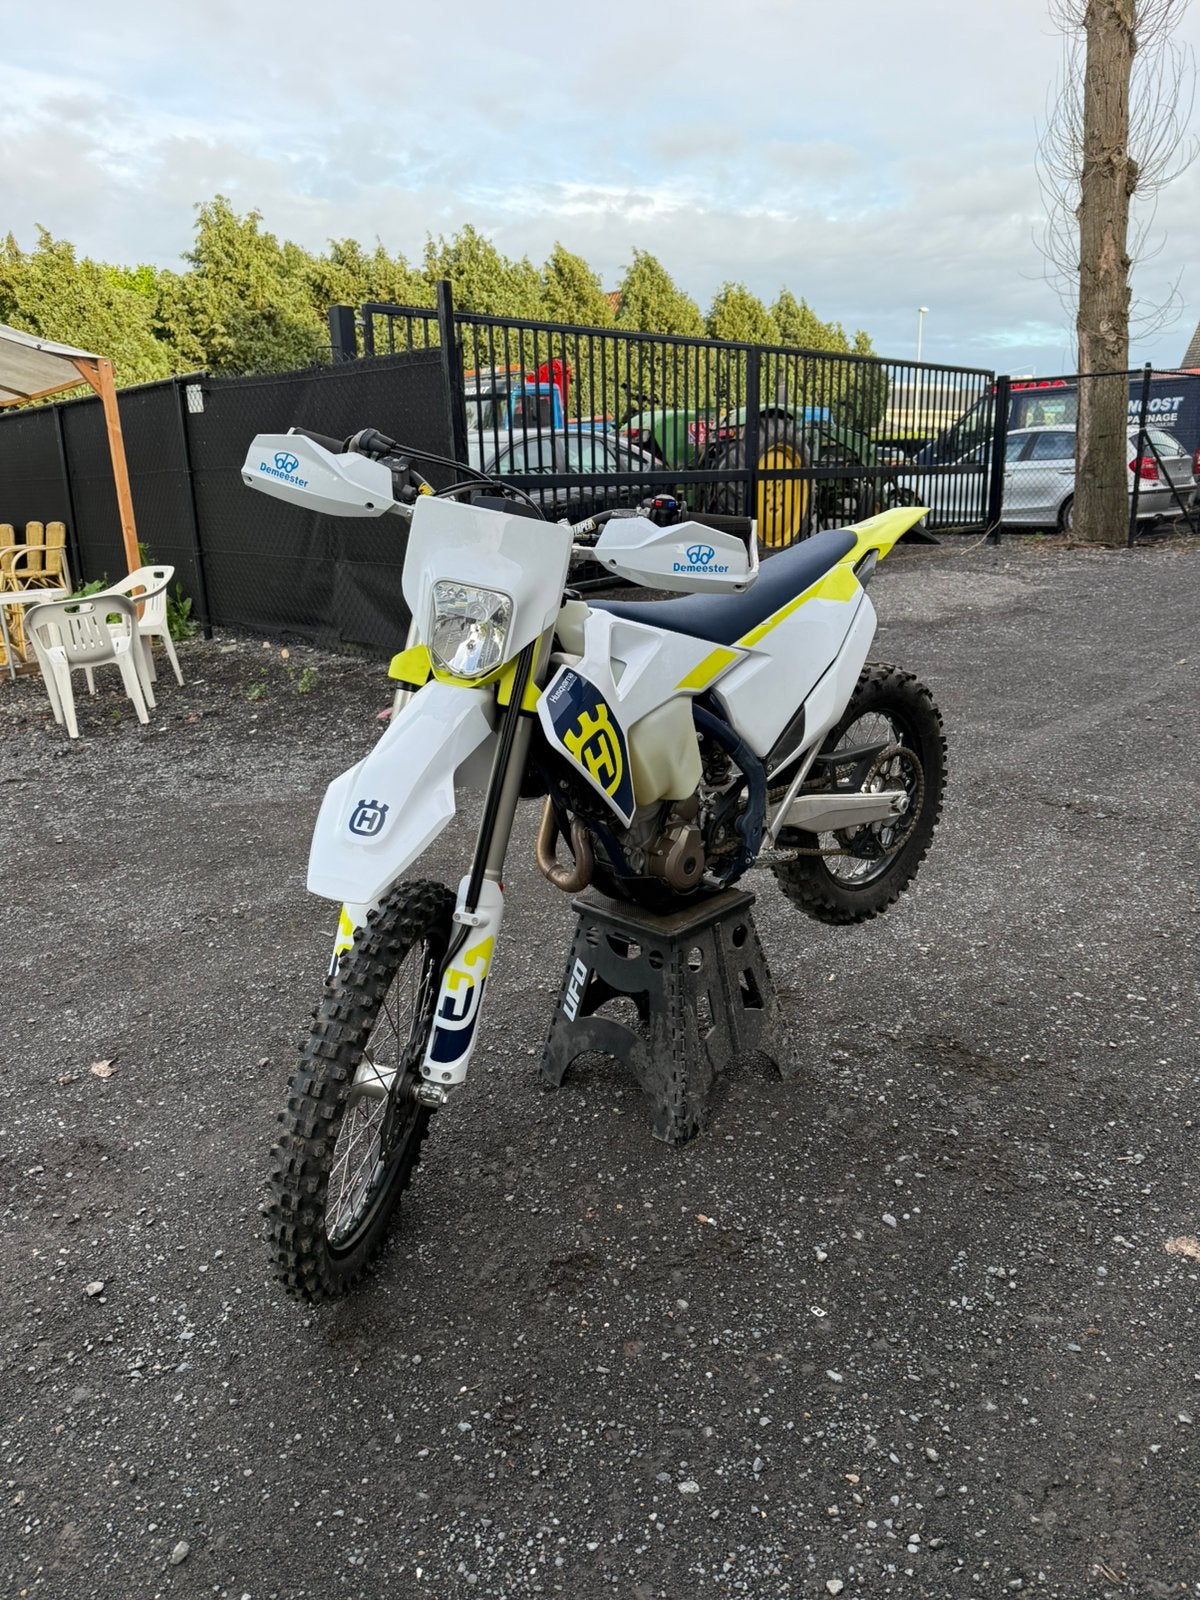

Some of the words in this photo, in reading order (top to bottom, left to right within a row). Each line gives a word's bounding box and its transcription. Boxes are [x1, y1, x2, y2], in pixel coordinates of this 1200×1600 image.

[1127, 413, 1178, 424] PANAGE
[259, 462, 309, 488] Demeester
[673, 562, 729, 573] Demeester
[549, 672, 575, 704] Husqvarna
[562, 957, 588, 1022] UFO
